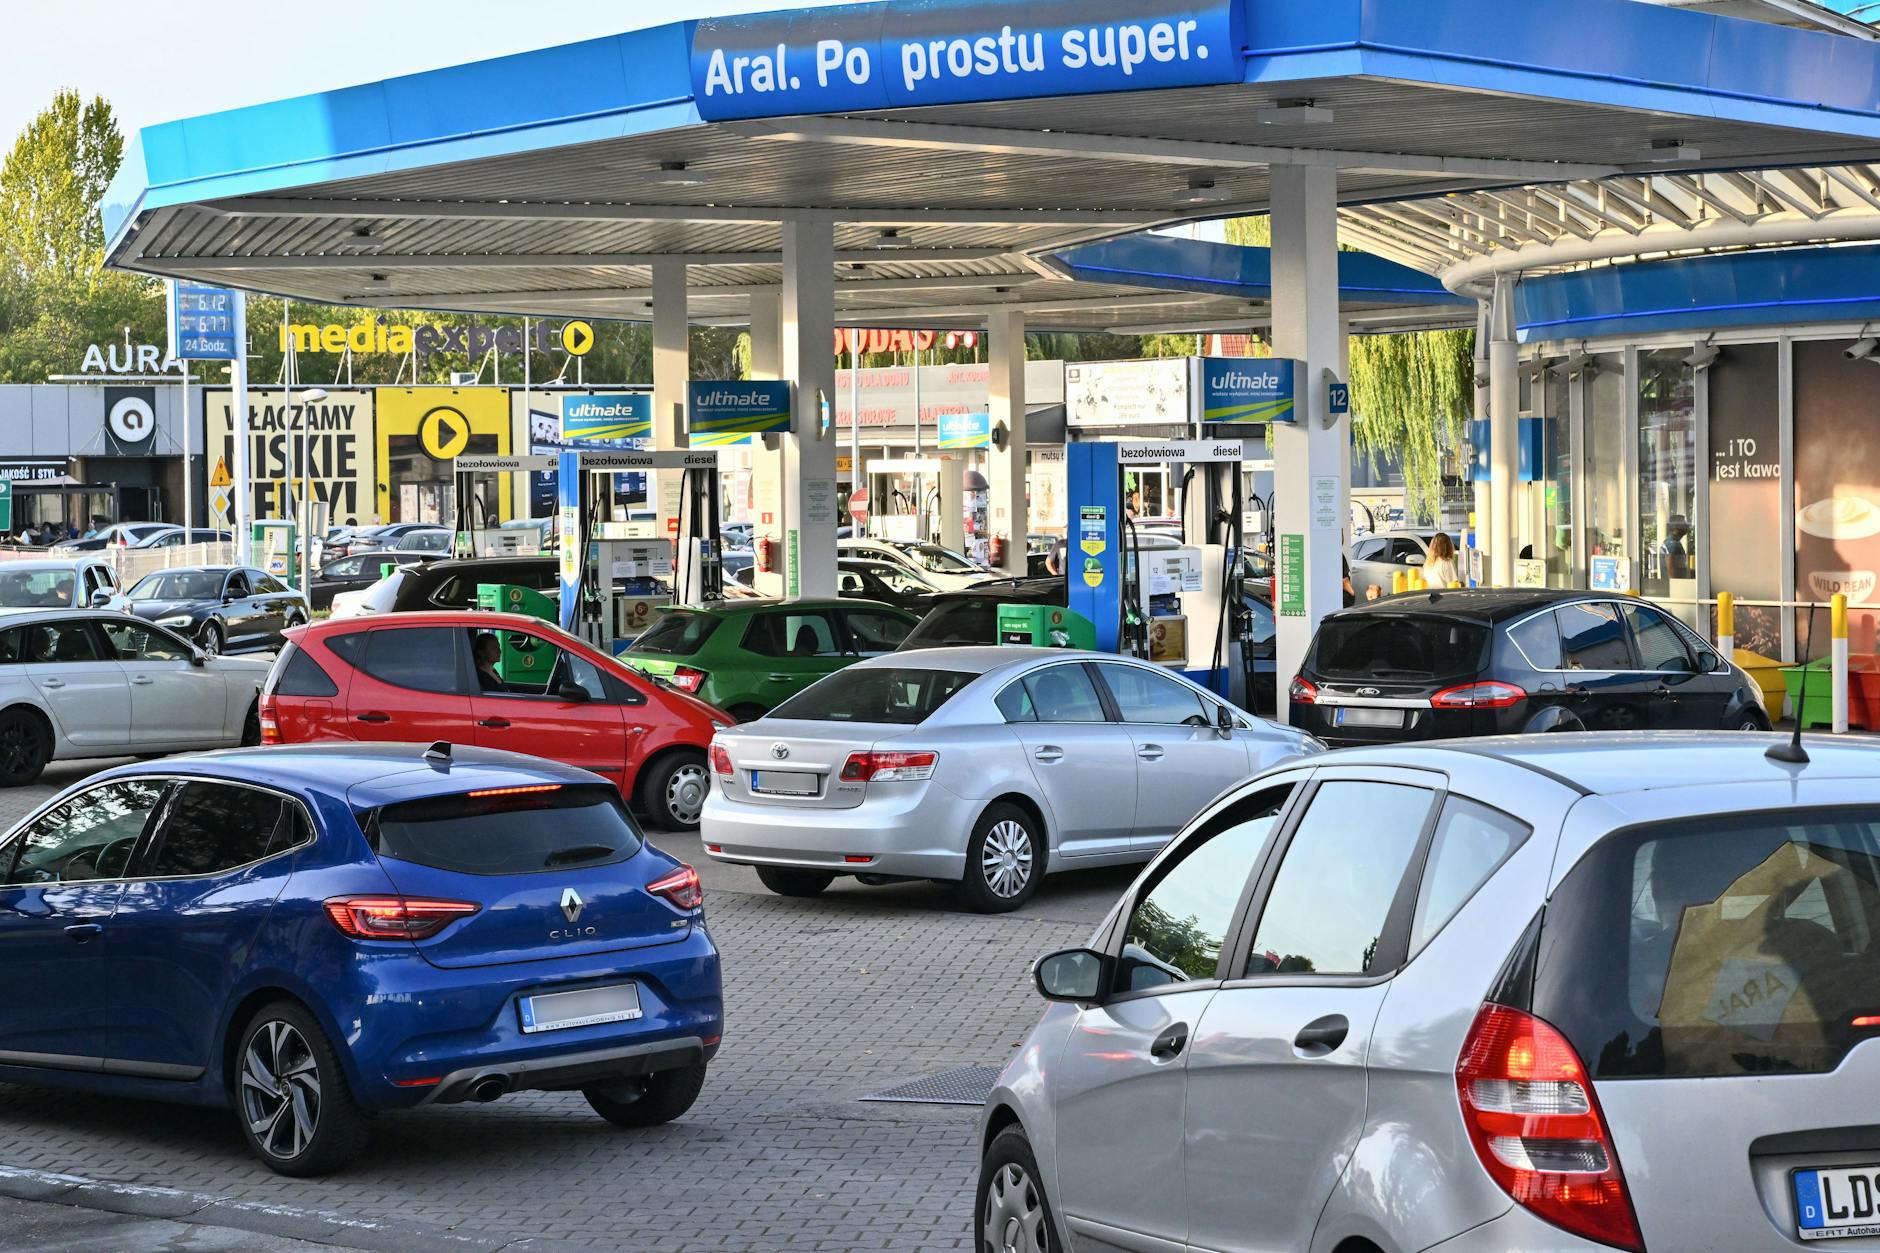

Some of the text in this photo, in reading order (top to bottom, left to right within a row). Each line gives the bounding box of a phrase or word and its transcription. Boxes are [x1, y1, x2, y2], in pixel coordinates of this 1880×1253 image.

[705, 20, 1208, 96] Aral. Po prostu super.
[184, 339, 227, 352] 24 Godz.
[81, 344, 184, 372] AURA
[1211, 371, 1278, 389] ultimate
[697, 391, 770, 406] ultimate
[1330, 389, 1346, 406] 12
[569, 403, 632, 416] ultimate
[1121, 445, 1241, 458] bezołowiowa diesel
[1729, 439, 1733, 457] i
[1737, 438, 1757, 457] TO
[456, 460, 520, 468] bezołowiowa
[581, 454, 716, 466] bezołowiowa diesel
[38, 469, 56, 480] STYL
[1716, 460, 1741, 482] jest
[1813, 575, 1872, 593] WILD BEAN
[549, 926, 596, 939] CLIO
[1822, 1174, 1880, 1219] LD
[1805, 1205, 1816, 1219] D
[1808, 1229, 1844, 1237] EAT
